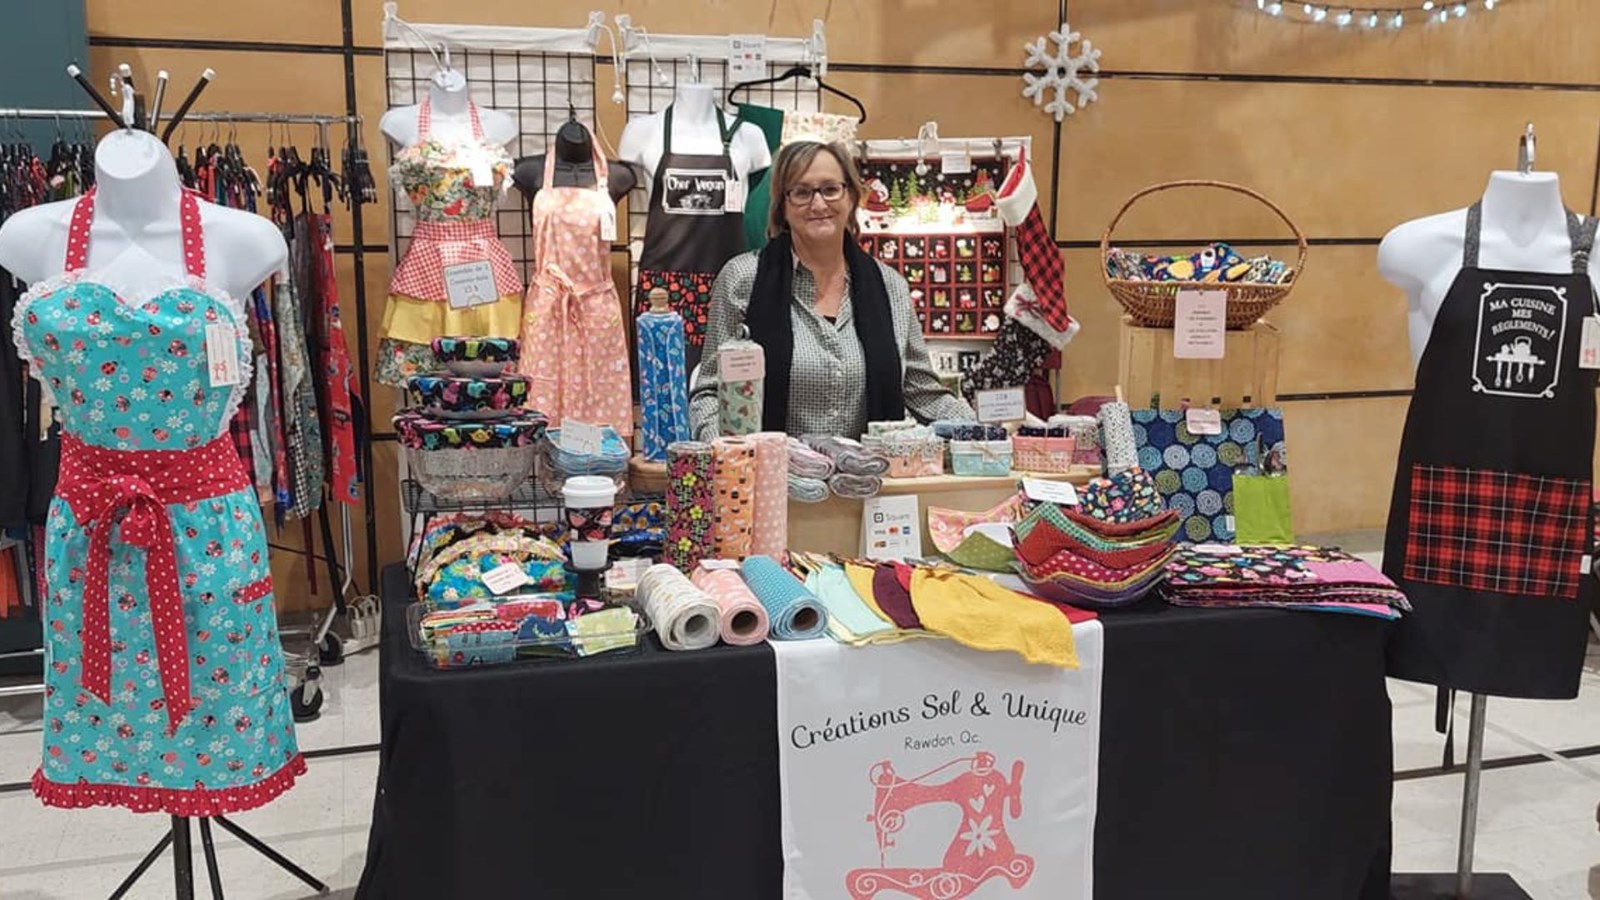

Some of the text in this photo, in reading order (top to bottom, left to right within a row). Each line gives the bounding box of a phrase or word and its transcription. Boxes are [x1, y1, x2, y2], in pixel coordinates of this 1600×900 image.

[694, 177, 725, 192] Vegan
[1489, 297, 1557, 316] MA CUISINE
[1511, 308, 1532, 319] MES
[790, 689, 1087, 749] Créations Sol & Unique
